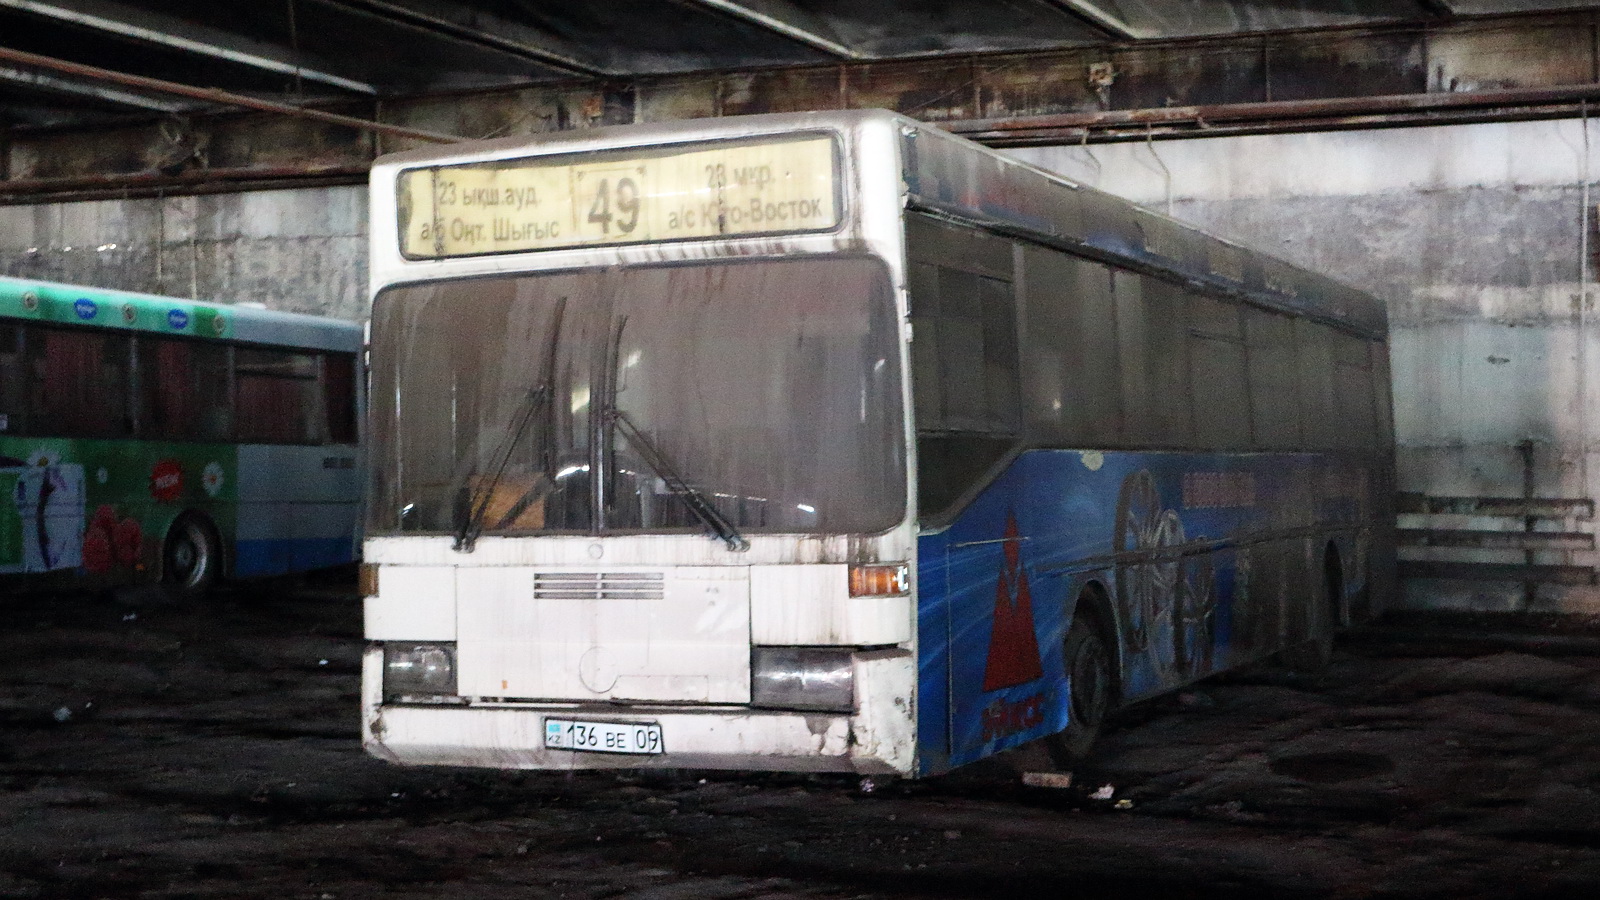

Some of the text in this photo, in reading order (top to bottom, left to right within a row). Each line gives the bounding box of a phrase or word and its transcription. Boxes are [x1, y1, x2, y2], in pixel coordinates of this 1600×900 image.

[705, 163, 727, 189] 23
[438, 181, 457, 206] 23
[586, 177, 641, 235] 49
[493, 217, 560, 242] Шығыс
[668, 204, 695, 230] а/с
[567, 724, 598, 747] 136
[635, 729, 659, 751] 09
